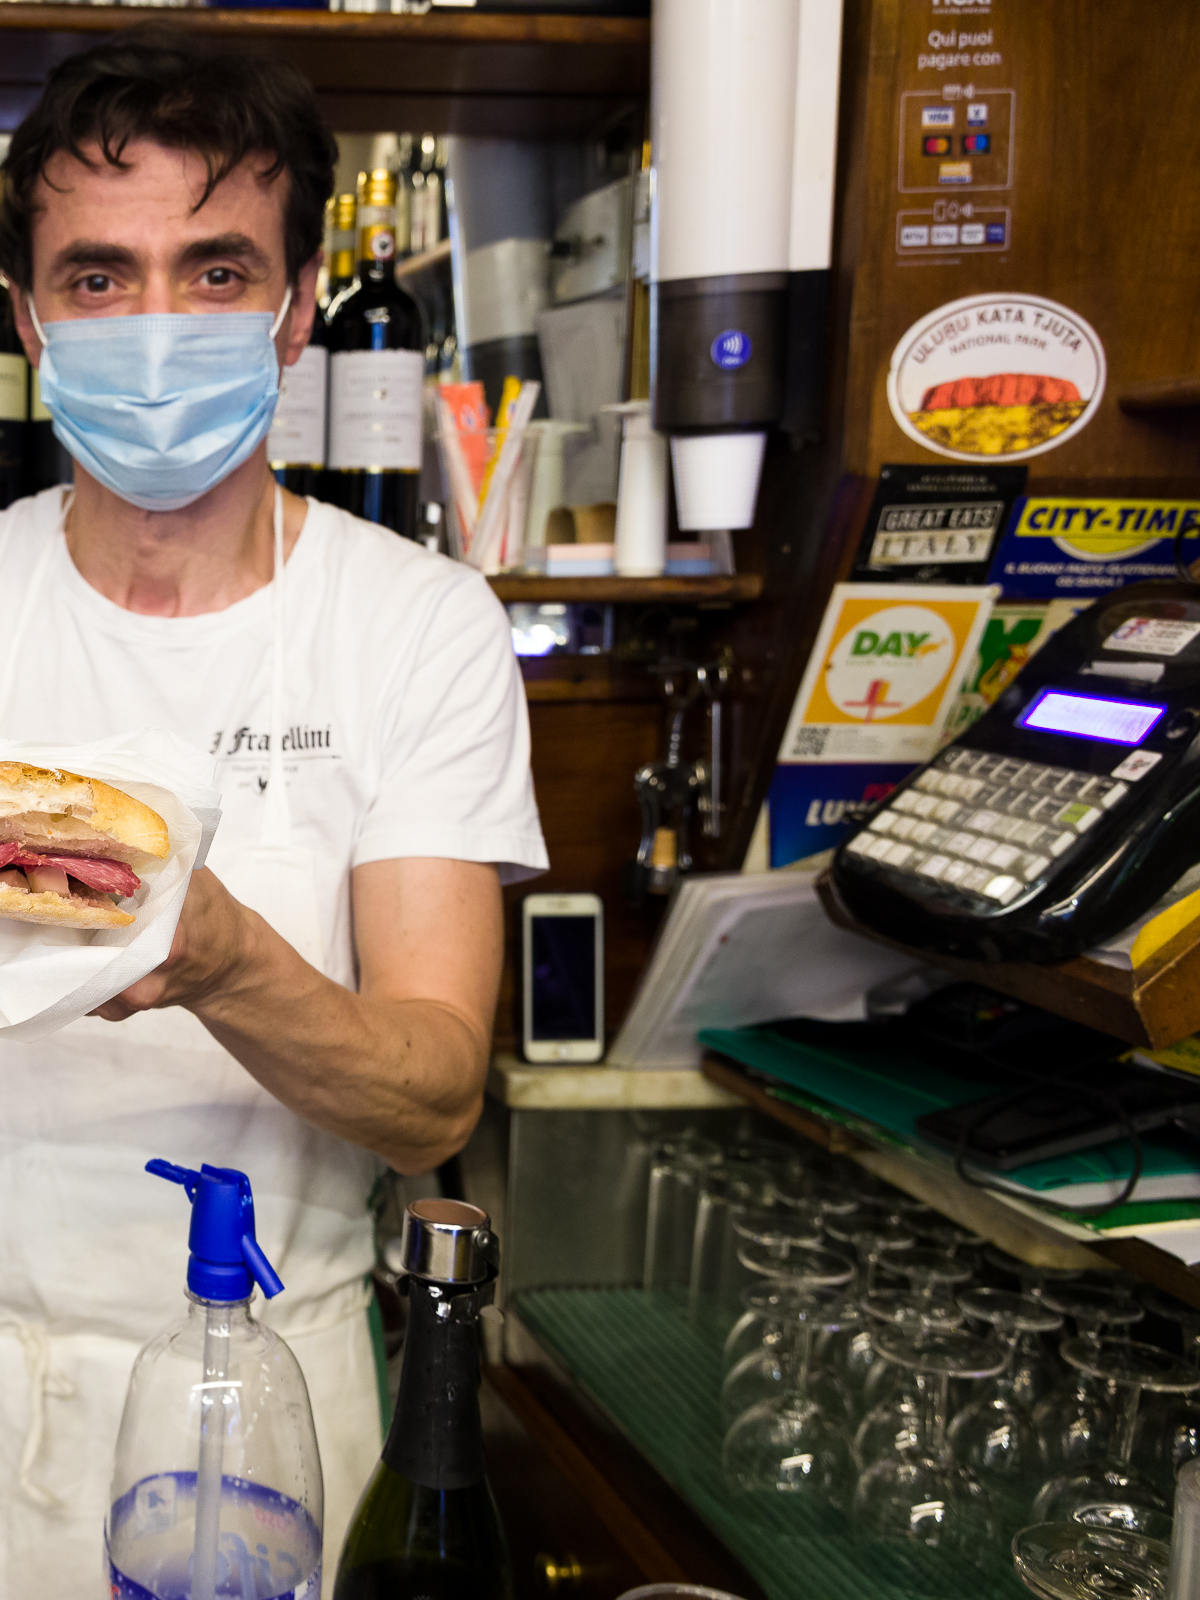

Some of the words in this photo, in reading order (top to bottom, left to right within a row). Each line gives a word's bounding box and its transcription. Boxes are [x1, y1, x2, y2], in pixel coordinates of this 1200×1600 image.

[928, 29, 957, 49] Qui
[958, 28, 993, 50] puoi
[918, 52, 971, 71] pagare
[972, 52, 1002, 66] con
[912, 316, 969, 364] ULURU
[977, 308, 1025, 325] KATA
[1033, 312, 1082, 353] TJUTA
[950, 334, 1010, 354] NATIONAL
[1015, 334, 1048, 350] PARK
[886, 510, 945, 531] GREAT
[948, 508, 994, 528] EATS
[881, 535, 986, 558] ITALY
[851, 630, 931, 657] DAY
[227, 724, 331, 756] Fraellini
